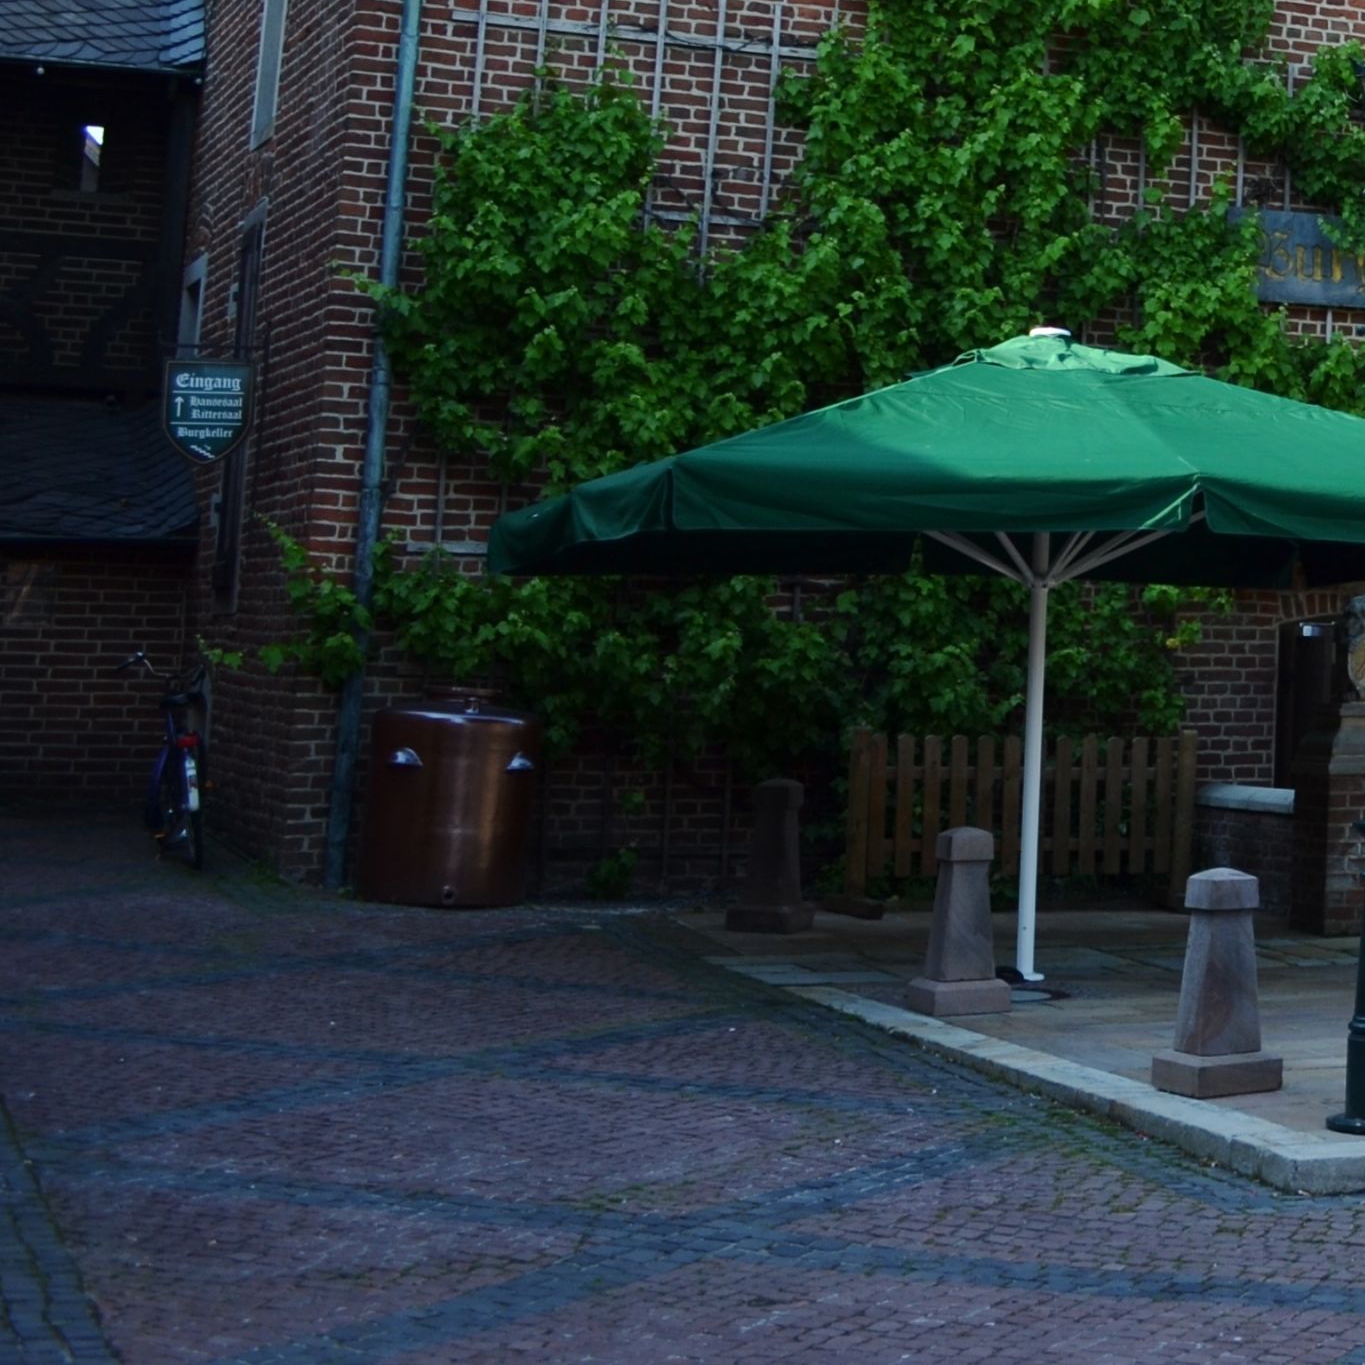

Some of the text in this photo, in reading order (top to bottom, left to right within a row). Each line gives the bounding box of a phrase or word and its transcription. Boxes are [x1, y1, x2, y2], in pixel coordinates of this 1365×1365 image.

[176, 373, 242, 391] Eingang
[191, 409, 242, 420] Rittersaal
[178, 427, 233, 439] Burgkeller
